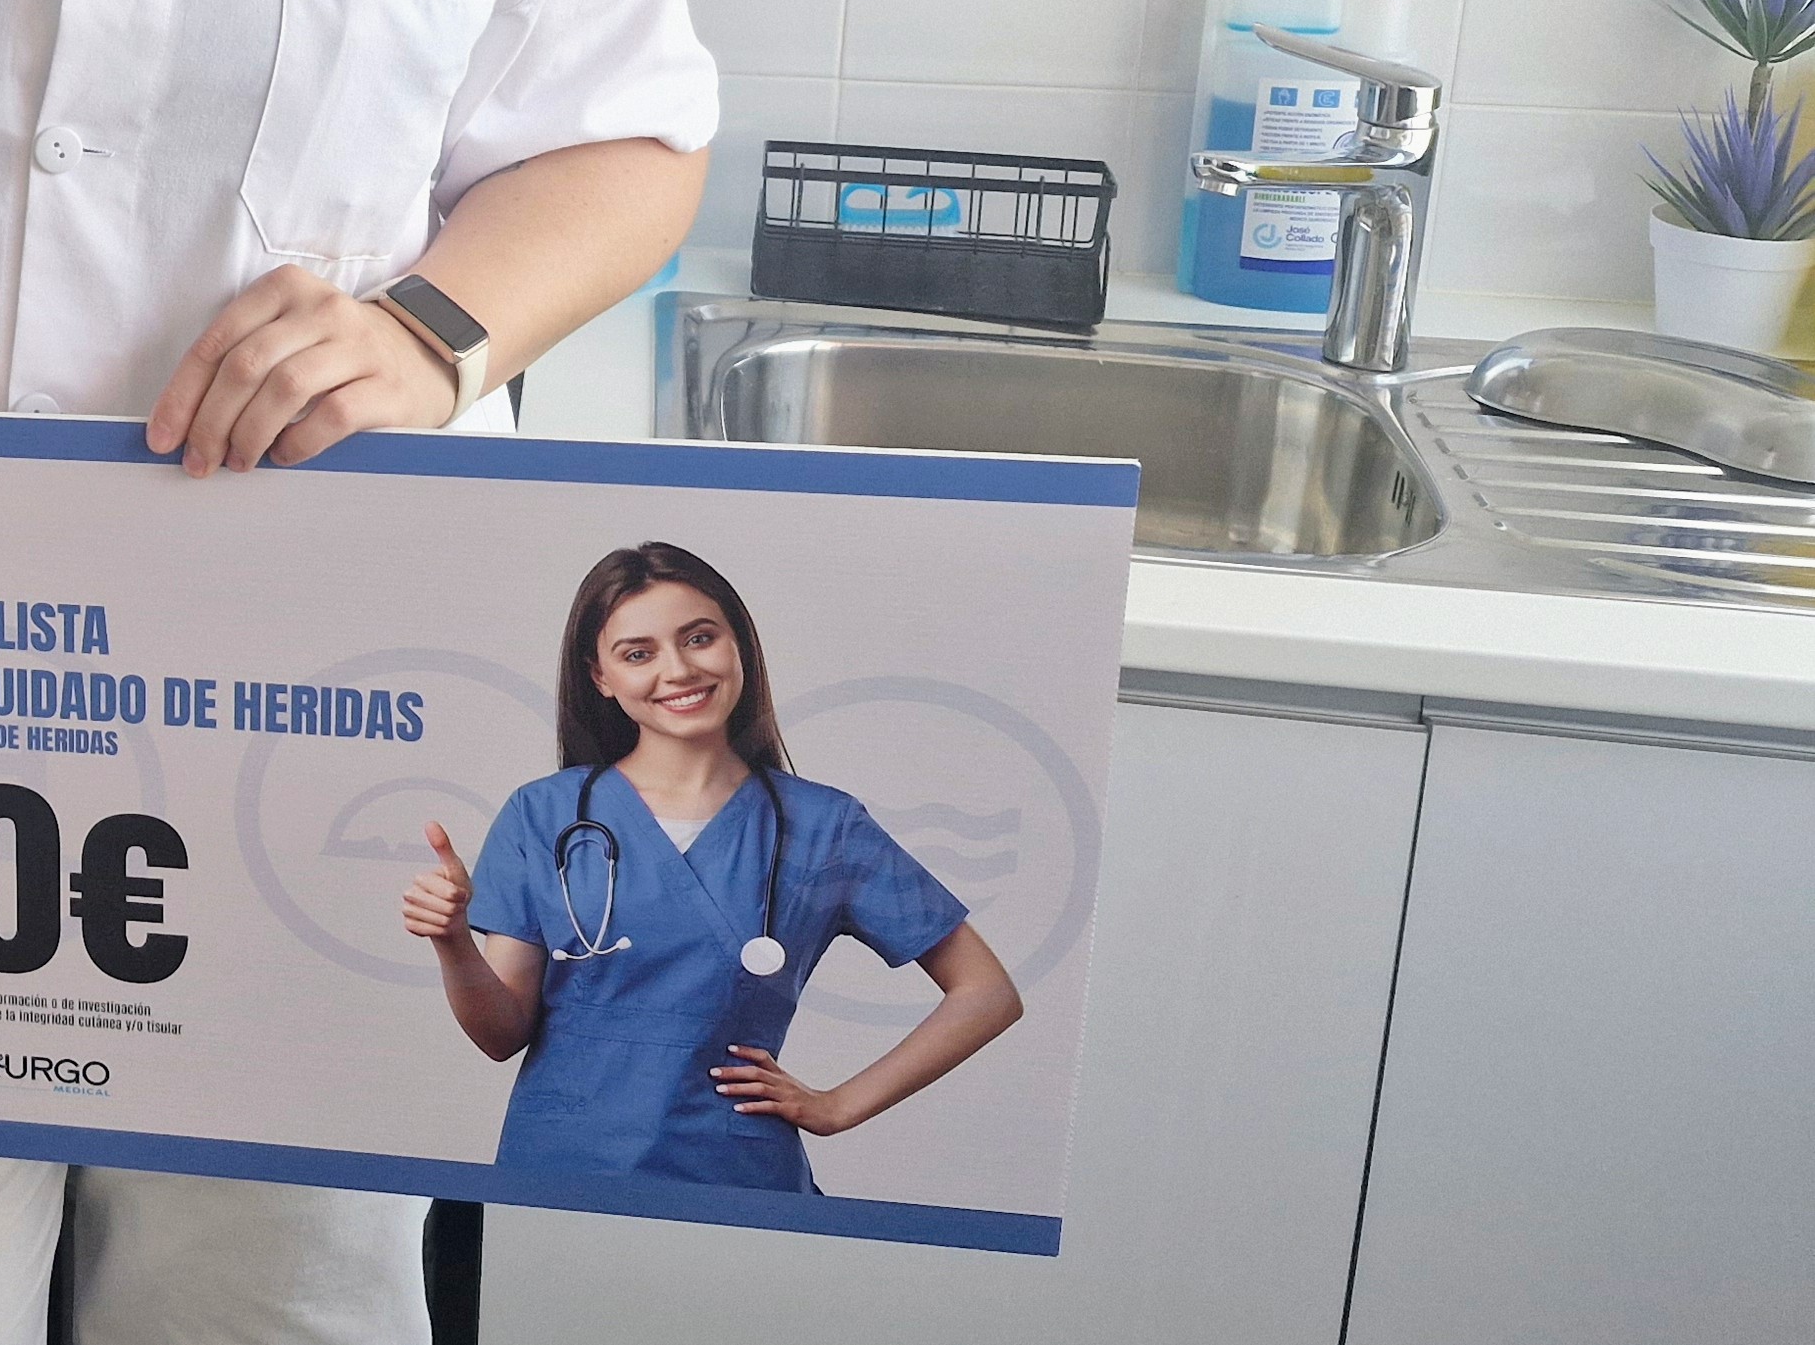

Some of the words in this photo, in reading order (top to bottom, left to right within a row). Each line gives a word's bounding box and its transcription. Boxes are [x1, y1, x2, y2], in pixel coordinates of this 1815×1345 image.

[1286, 225, 1310, 234] José
[1286, 233, 1324, 243] Collado
[163, 677, 217, 729] DE
[233, 681, 424, 742] HERIDAS
[27, 727, 118, 756] HERIDAS
[51, 999, 57, 1009] o
[61, 997, 74, 1010] de
[78, 999, 151, 1016] investigación
[6, 1008, 16, 1021] la
[19, 1009, 75, 1027] integridad
[78, 1015, 122, 1030] cutánea
[125, 1017, 143, 1032] y/o
[147, 1020, 183, 1035] tisular
[4, 1053, 111, 1086] URGO
[53, 1085, 111, 1097] MEDICAL
